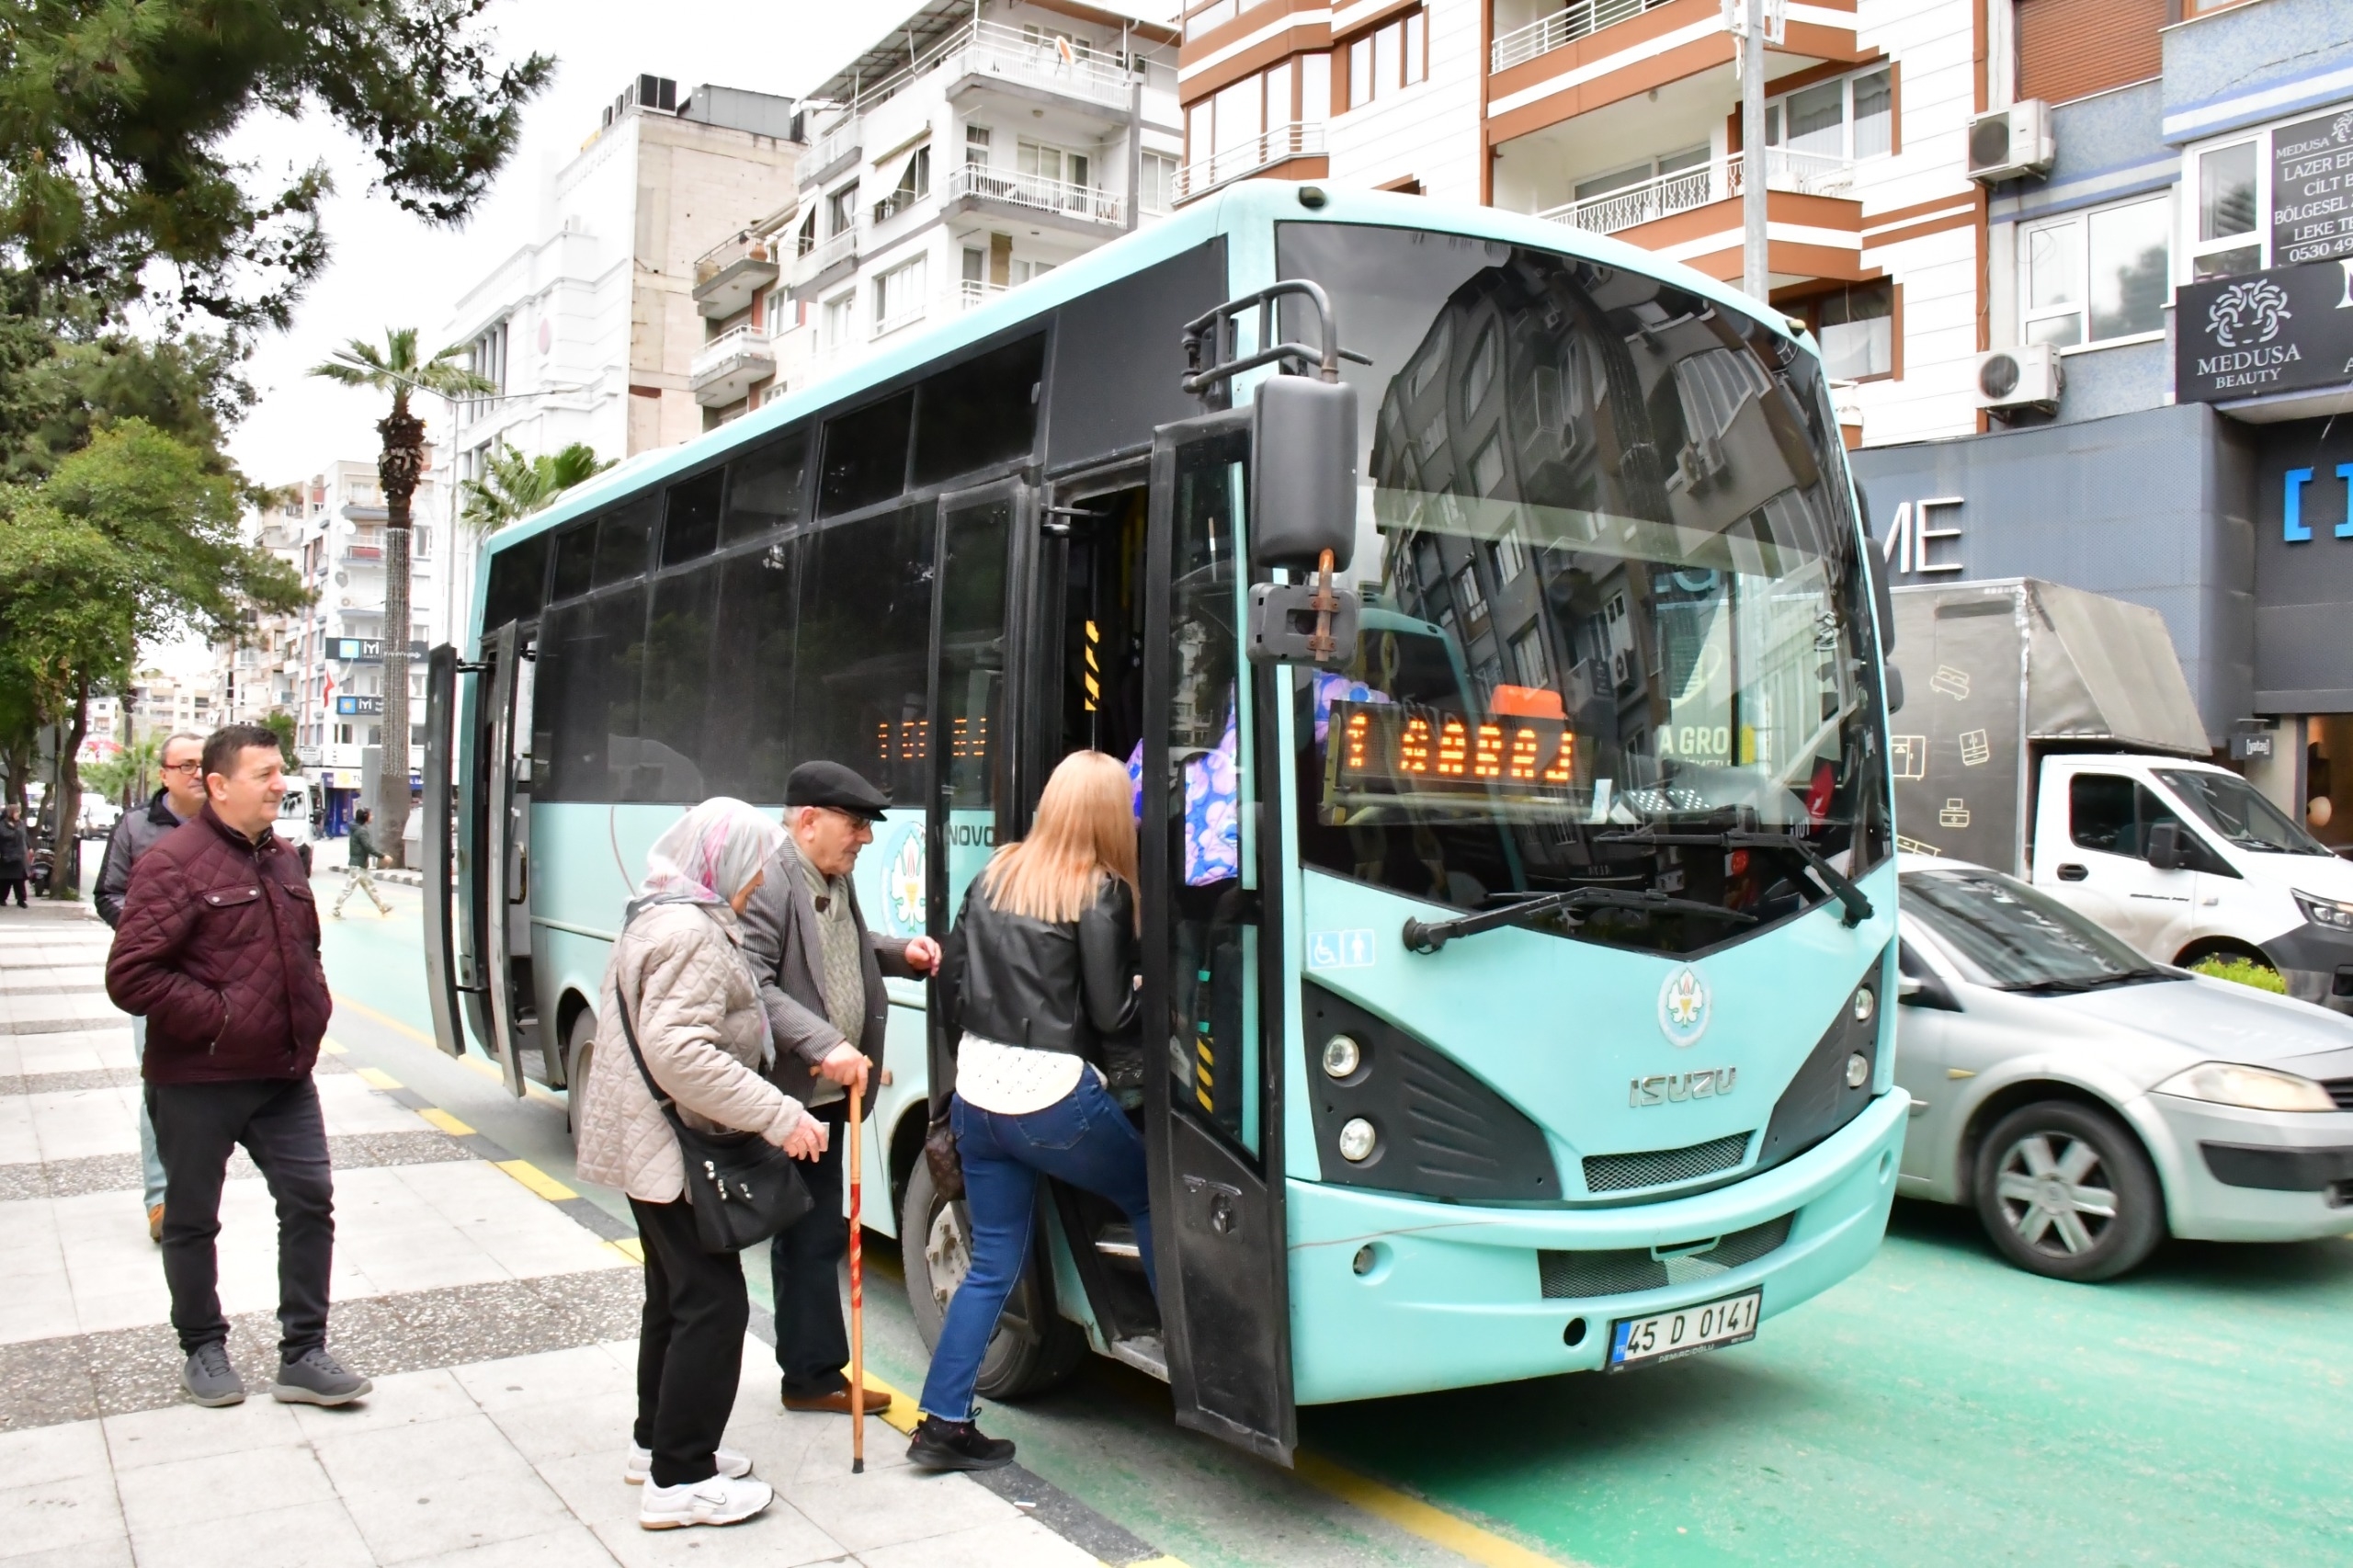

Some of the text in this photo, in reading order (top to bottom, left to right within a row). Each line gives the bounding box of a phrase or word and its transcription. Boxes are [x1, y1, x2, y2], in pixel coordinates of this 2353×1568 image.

[2276, 138, 2329, 159] MEDUSA
[2284, 157, 2332, 182] LAZER
[2303, 176, 2341, 197] CİLT
[2274, 196, 2347, 225] BÖLGESEL
[2294, 221, 2335, 242] LEKE
[2289, 243, 2330, 263] 0530
[2197, 343, 2302, 376] MEDUSA
[2214, 368, 2281, 390] BEAUTY
[1347, 713, 1367, 767] 1
[1629, 1065, 1736, 1108] ISUZU
[1627, 1300, 1753, 1355] 45 D 0141
[1615, 1344, 1627, 1356] TR
